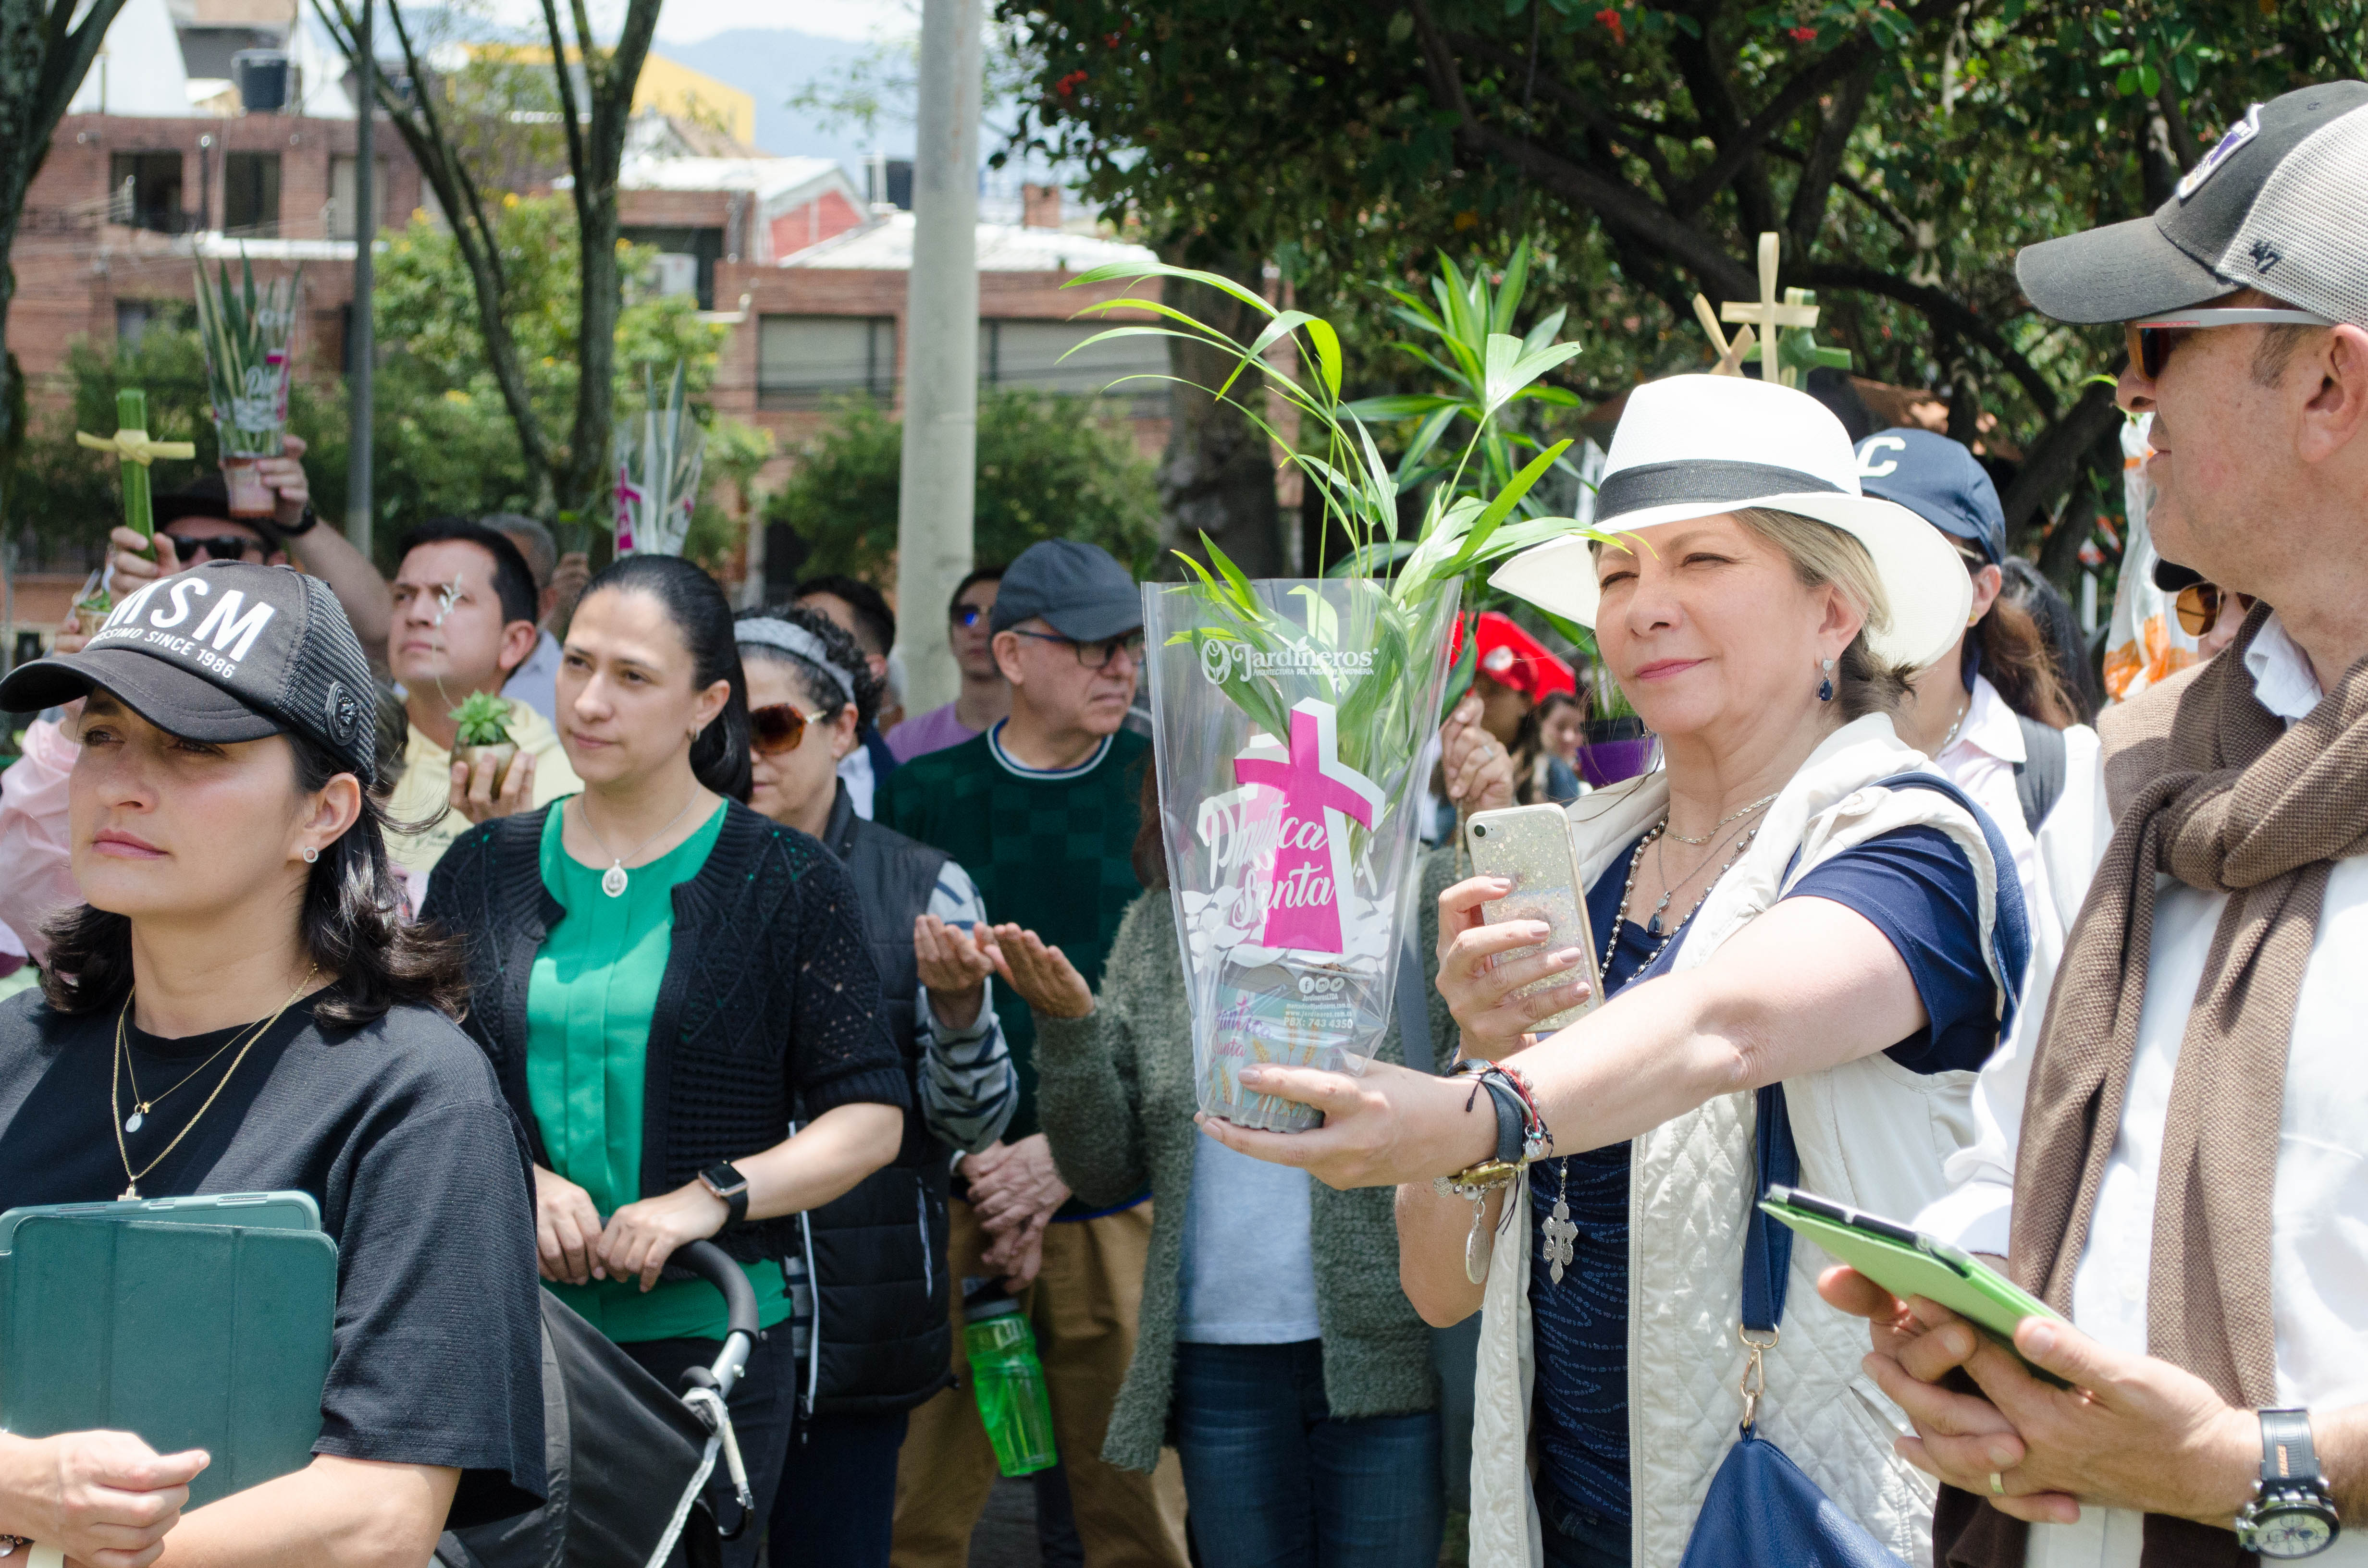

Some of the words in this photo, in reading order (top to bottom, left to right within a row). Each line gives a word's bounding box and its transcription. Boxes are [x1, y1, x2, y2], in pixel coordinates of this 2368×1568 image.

[1858, 437, 1906, 477] C
[99, 577, 275, 662] MSM
[145, 631, 196, 656] SINCE
[196, 649, 236, 679] 1986
[1233, 861, 1335, 928] Santa
[1284, 1017, 1306, 1026] PBX:
[1308, 1018, 1326, 1028] 743
[1329, 1018, 1353, 1029] 4350
